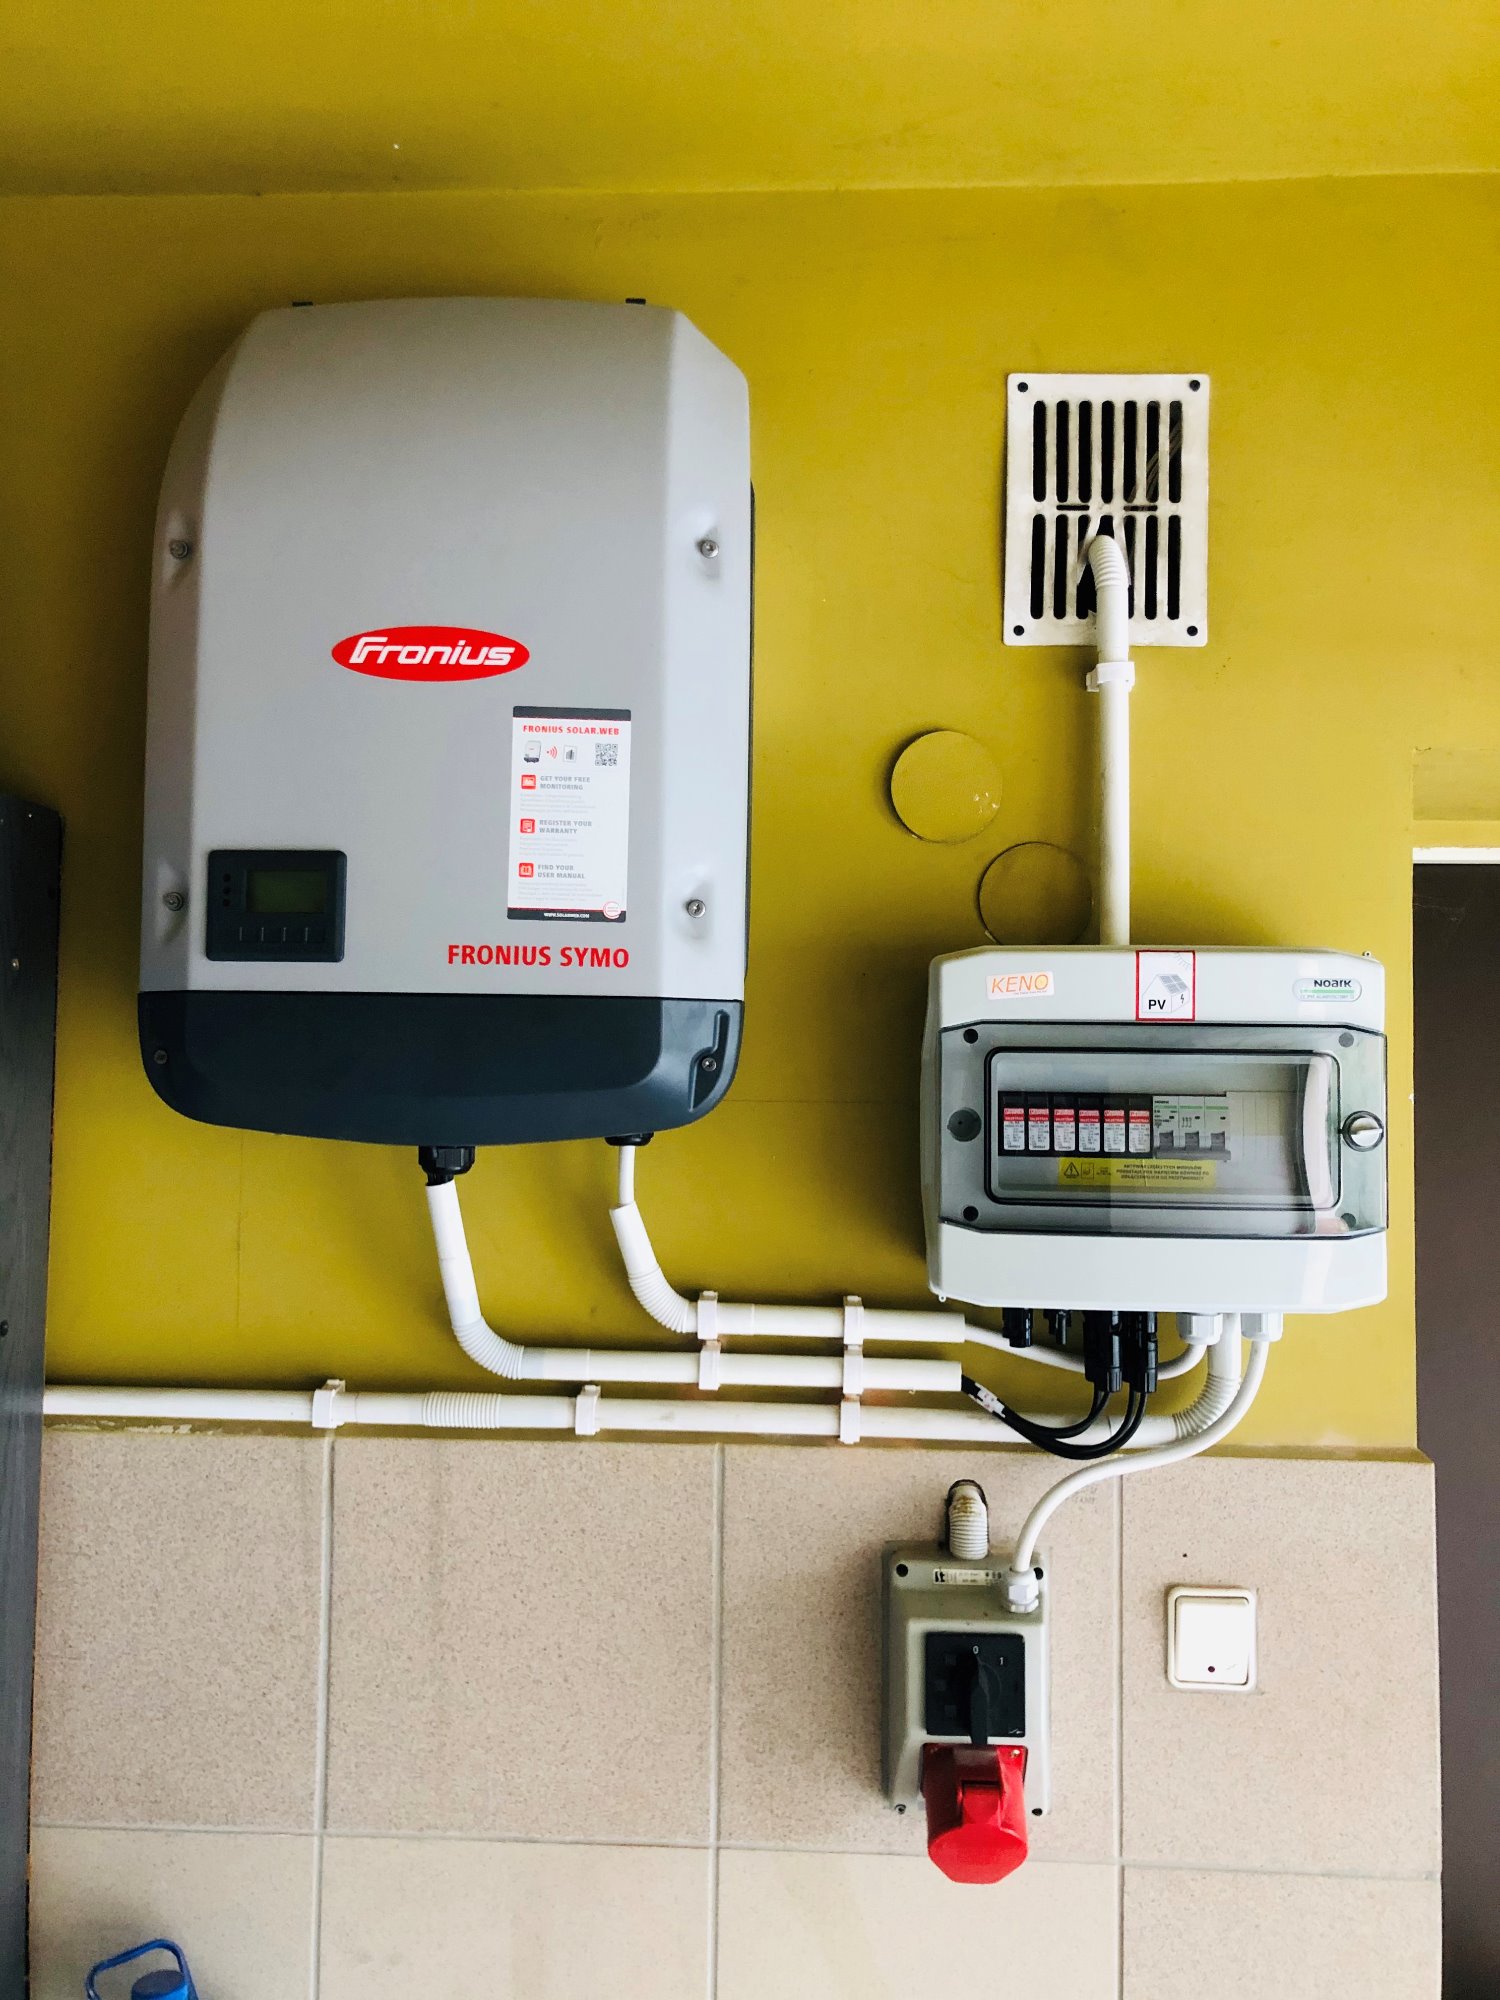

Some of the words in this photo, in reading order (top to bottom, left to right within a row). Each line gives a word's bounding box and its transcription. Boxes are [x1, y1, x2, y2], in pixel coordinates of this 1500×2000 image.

[348, 636, 516, 666] Fronius
[523, 725, 563, 734] FRONIUS
[566, 726, 620, 736] SOLAR.WEB
[540, 783, 584, 791] MONITORING
[539, 819, 571, 827] REGISTER
[539, 827, 578, 835] WARRANTY
[447, 944, 551, 966] FRONIUS
[560, 946, 630, 968] SYMO
[991, 974, 1049, 993] KENO
[1148, 999, 1166, 1010] PV
[972, 1645, 979, 1655] 0
